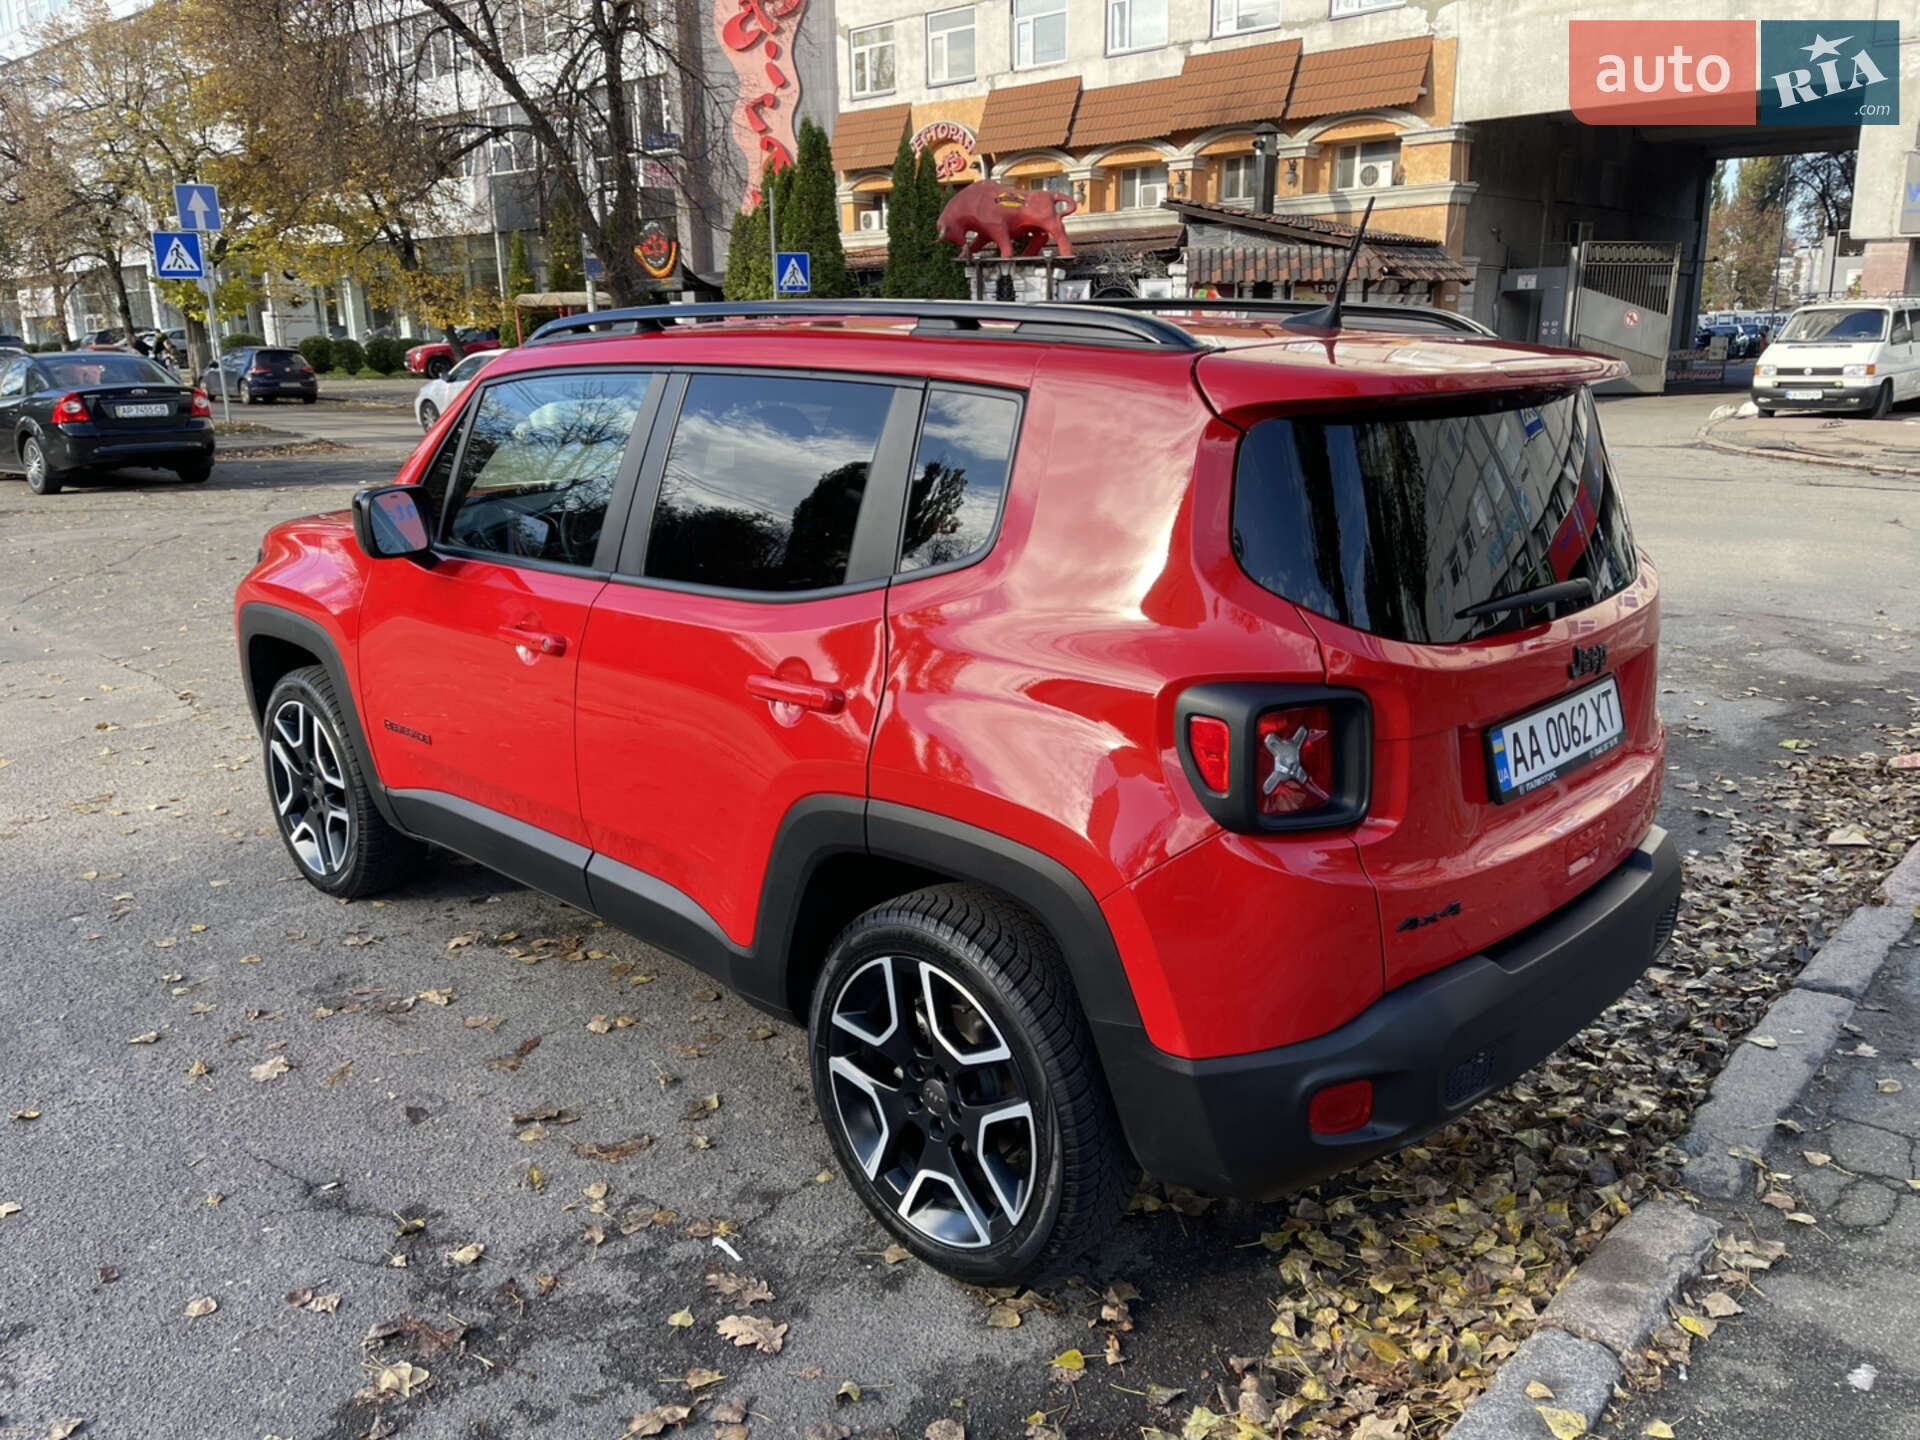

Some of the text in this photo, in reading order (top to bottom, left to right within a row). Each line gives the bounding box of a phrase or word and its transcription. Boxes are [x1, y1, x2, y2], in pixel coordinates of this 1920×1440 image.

[912, 123, 977, 155] ЕСТОРАН
[1568, 644, 1609, 680] Jeep
[1512, 725, 1546, 778] AA
[1546, 702, 1592, 758] 0062
[1590, 688, 1615, 737] XT
[1497, 767, 1511, 784] UA
